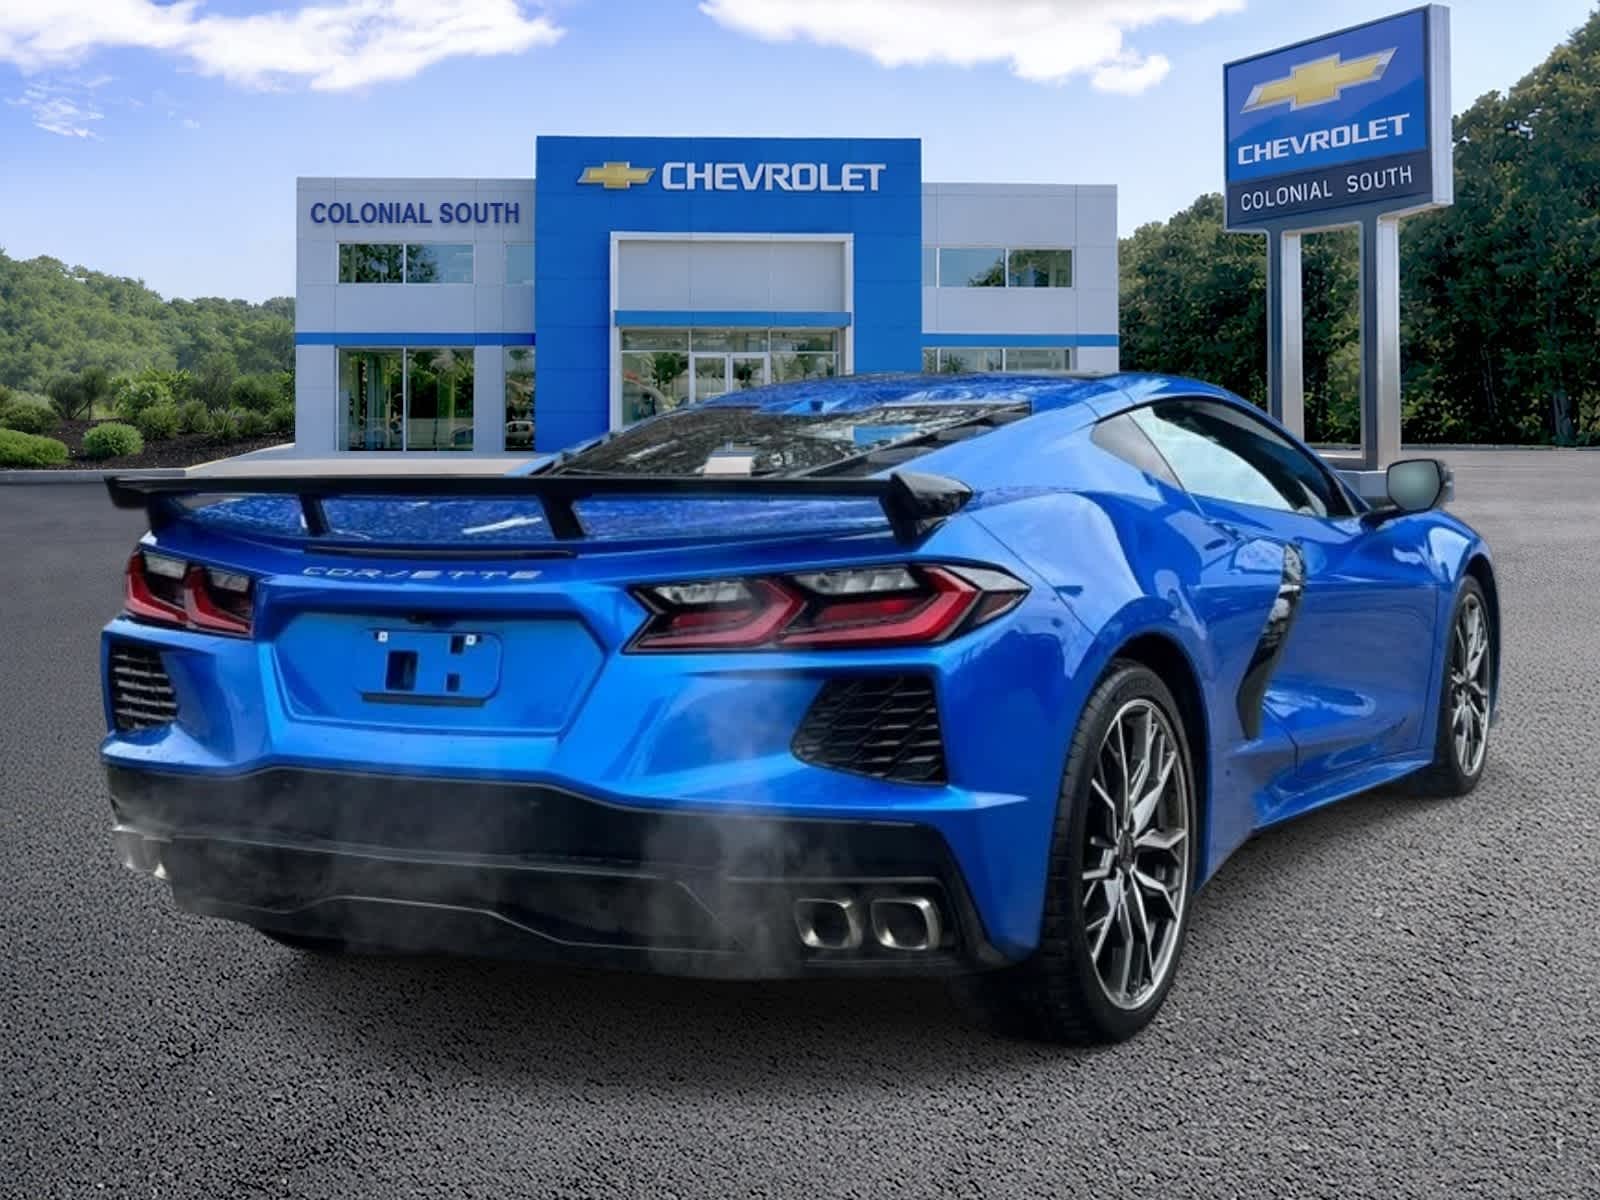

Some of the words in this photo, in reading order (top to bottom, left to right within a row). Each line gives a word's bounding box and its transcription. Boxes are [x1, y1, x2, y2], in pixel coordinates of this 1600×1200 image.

[1238, 113, 1410, 165] CHEVROLET
[662, 162, 887, 192] CHEVROLET
[1240, 180, 1333, 211] COLONIAL
[1346, 165, 1413, 193] SOUTH
[310, 202, 432, 224] COLONIAL
[439, 202, 520, 224] SOUTH
[303, 566, 542, 579] CORVETTE
